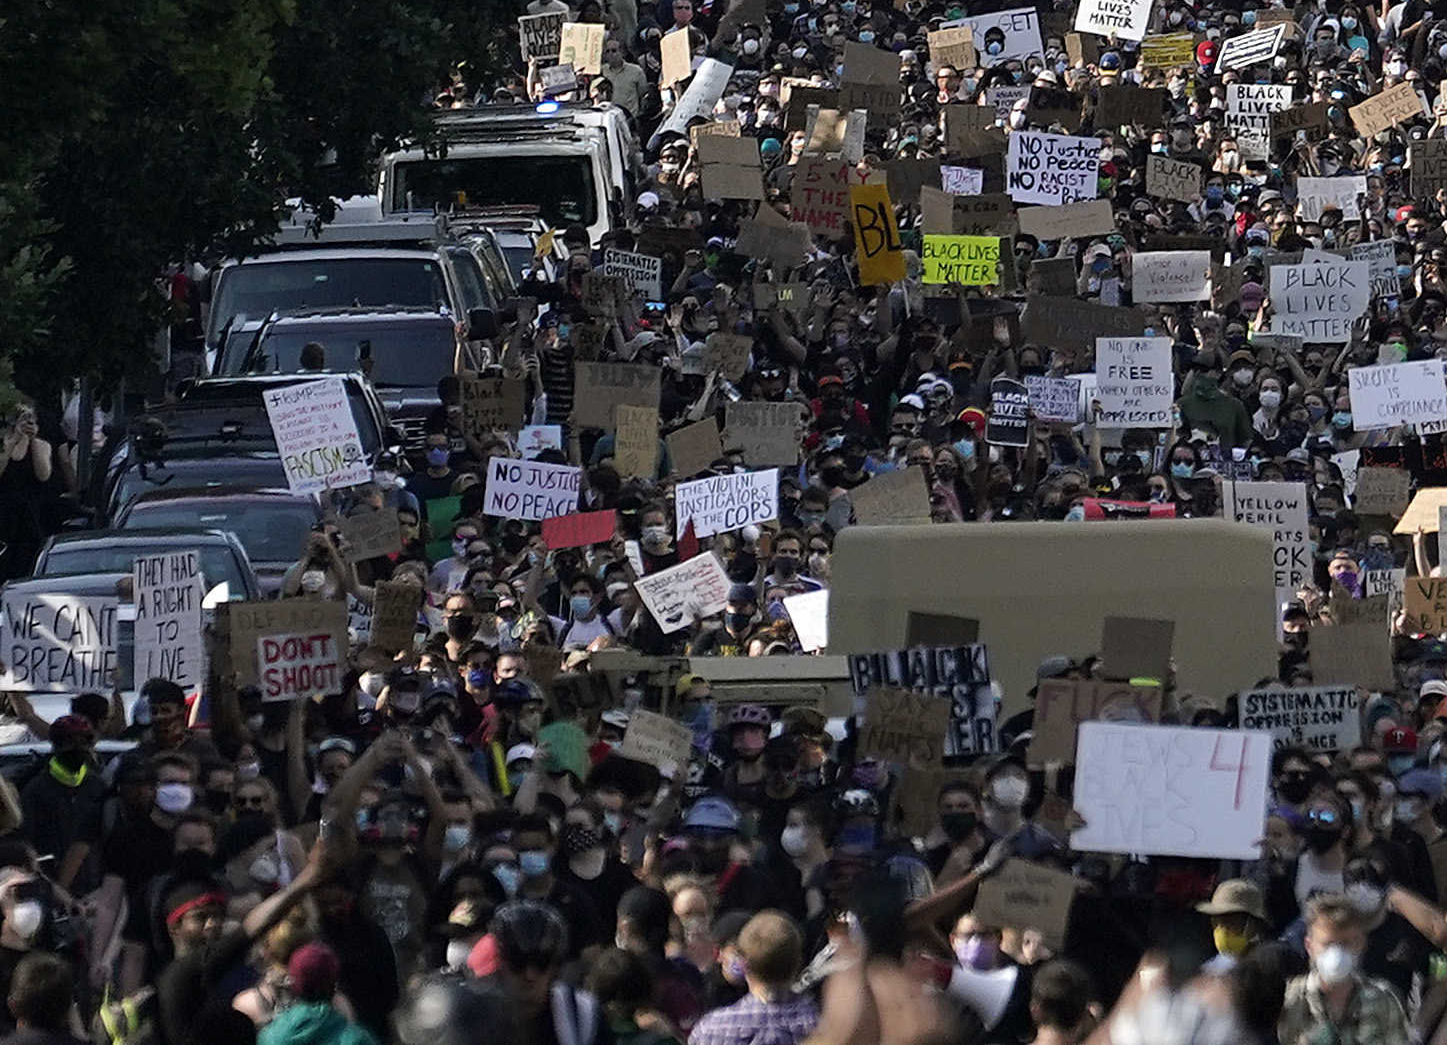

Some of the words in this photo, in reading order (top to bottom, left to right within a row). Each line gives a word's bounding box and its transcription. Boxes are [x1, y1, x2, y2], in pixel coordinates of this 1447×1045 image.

[1097, 0, 1133, 17] LIVES
[1089, 12, 1134, 30] MATTER
[1236, 86, 1284, 100] BLACK
[1238, 100, 1283, 113] LIVES
[1019, 136, 1042, 155] NO
[1018, 157, 1040, 171] NO
[1009, 171, 1034, 190] NO
[1041, 172, 1088, 186] RACIST
[1037, 184, 1060, 195] ASS
[802, 187, 848, 207] THE
[923, 242, 968, 262] BLACK
[967, 244, 999, 262] LIVES
[937, 263, 990, 283] MATTER
[1286, 267, 1356, 290] BLACK
[1286, 295, 1351, 314] LIVES
[1282, 318, 1351, 338] MATTER
[1108, 340, 1124, 352] NO
[1121, 355, 1133, 364] IS
[1108, 366, 1154, 380] FREE
[992, 392, 1029, 404] BLACK
[1387, 386, 1400, 399] IS
[992, 405, 1028, 416] LIVES
[988, 417, 1027, 428] MATTER
[495, 463, 522, 482] NO
[525, 468, 582, 493] JUSTICE
[678, 484, 703, 497] THE
[491, 491, 520, 512] NO
[520, 493, 579, 520] PEACE
[702, 512, 724, 526] THE
[724, 499, 773, 528] COPS
[1237, 499, 1298, 512] YELLOW
[1235, 513, 1285, 524] PERIL
[135, 556, 168, 589] THEY
[170, 553, 198, 580] HAD
[136, 598, 148, 621] A
[152, 585, 194, 616] RIGHT
[6, 602, 45, 641] WE
[156, 619, 180, 645] TO
[11, 645, 118, 689] BREATHE
[147, 648, 189, 683] LIVE
[850, 645, 990, 691] BLACK
[264, 663, 337, 697] SHOOT
[1244, 689, 1357, 714] SYSTEMATIC
[1243, 711, 1343, 728] OPPRESSION
[1209, 733, 1249, 811] 4
